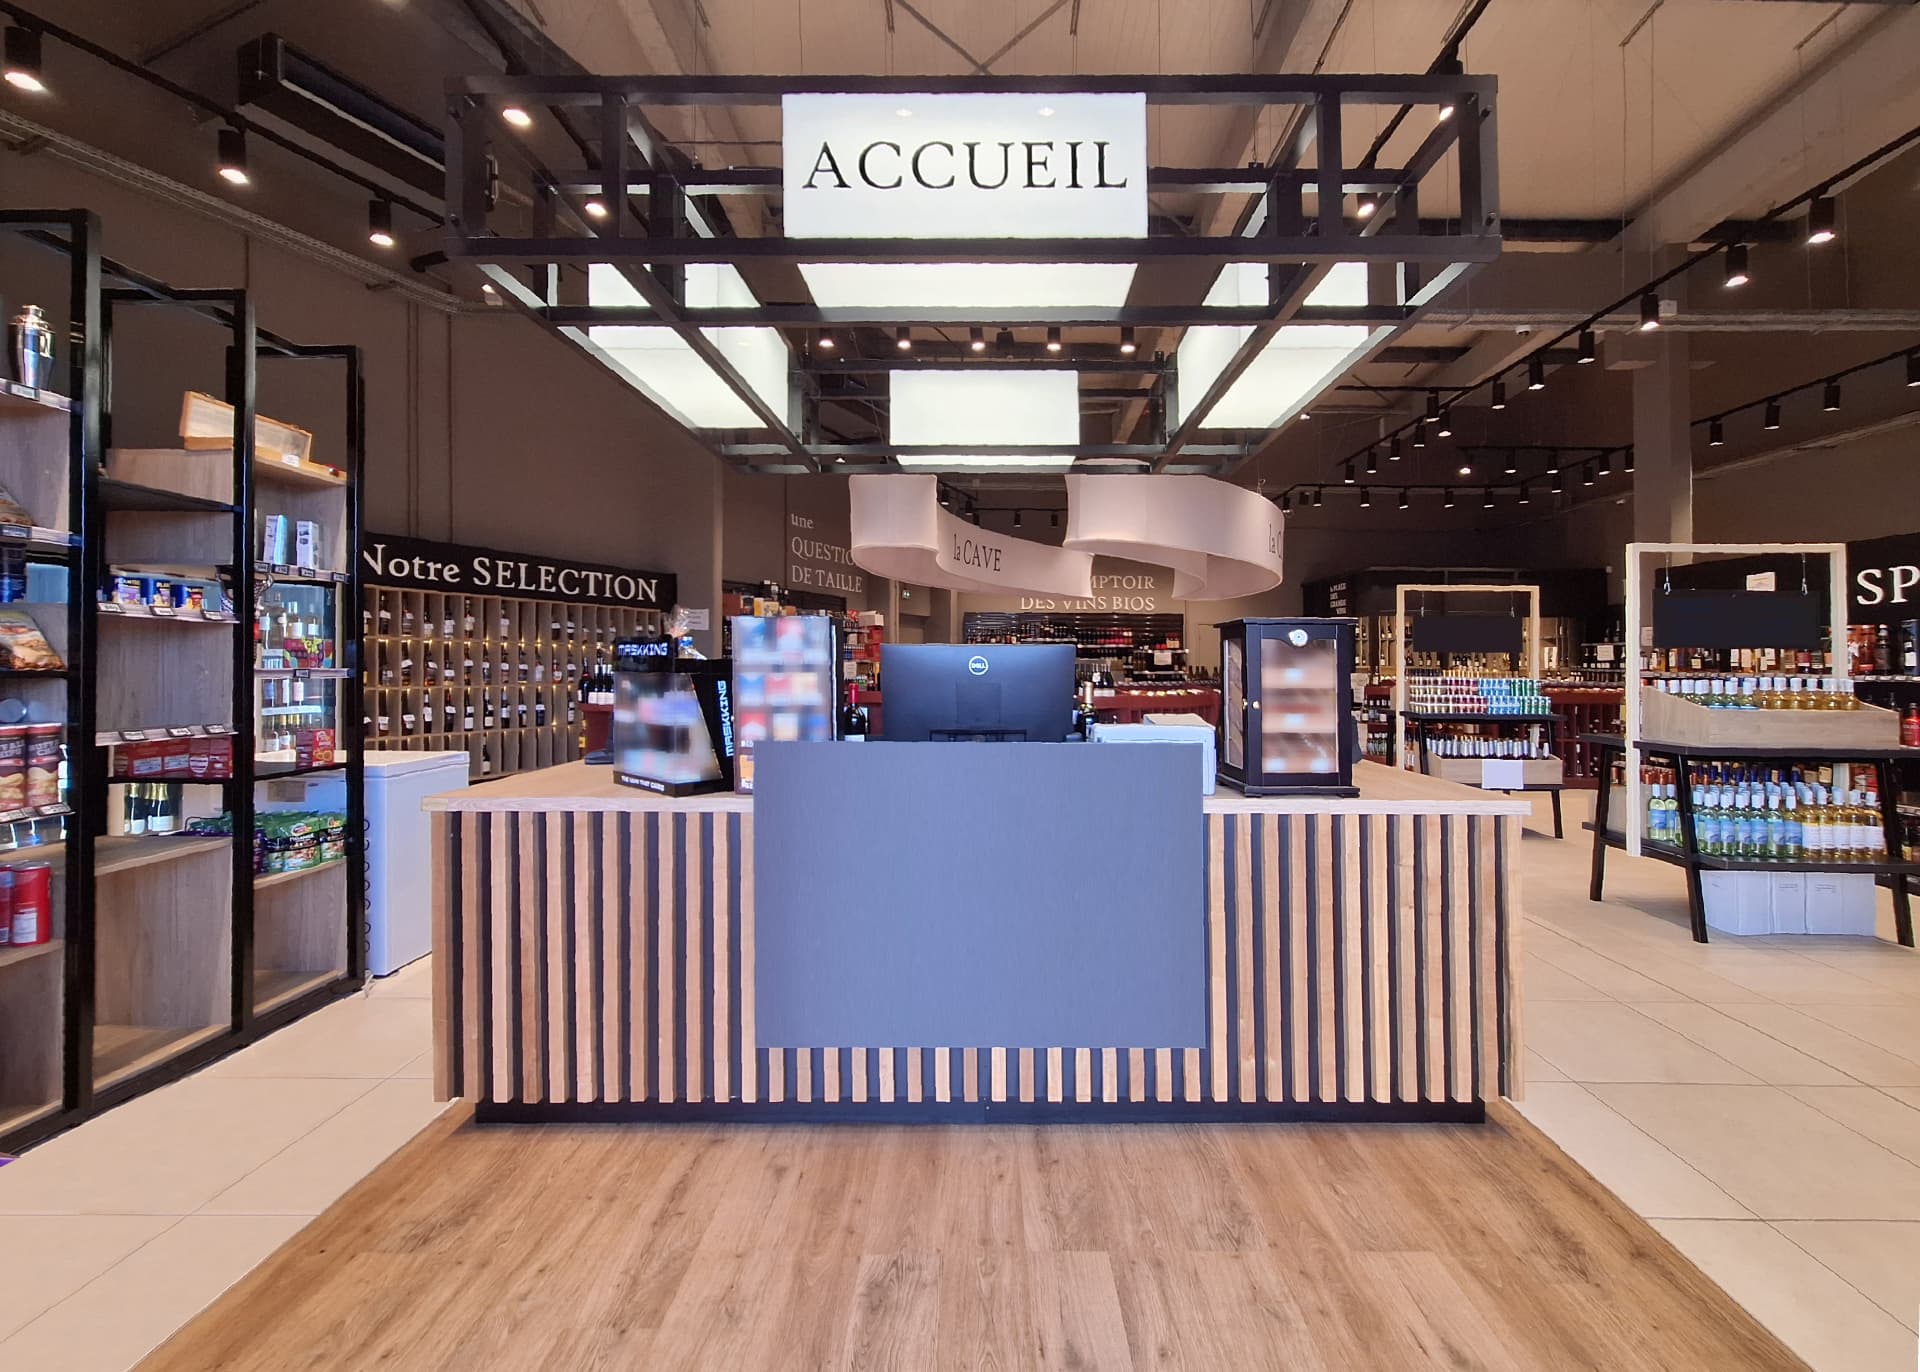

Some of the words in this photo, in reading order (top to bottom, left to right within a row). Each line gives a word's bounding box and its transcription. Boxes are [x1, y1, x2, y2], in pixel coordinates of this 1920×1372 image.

[802, 141, 1128, 190] ACCUEIL
[791, 513, 814, 529] une
[953, 533, 961, 561] la
[964, 539, 1002, 572] CAVE
[363, 543, 461, 583] Notre
[472, 556, 658, 603] SELECTION
[792, 565, 812, 585] DE
[815, 569, 862, 593] TAILLE
[1856, 565, 1920, 605] SP
[1020, 597, 1056, 611] DES
[1063, 596, 1107, 610] VINS
[1111, 596, 1155, 611] BIOS
